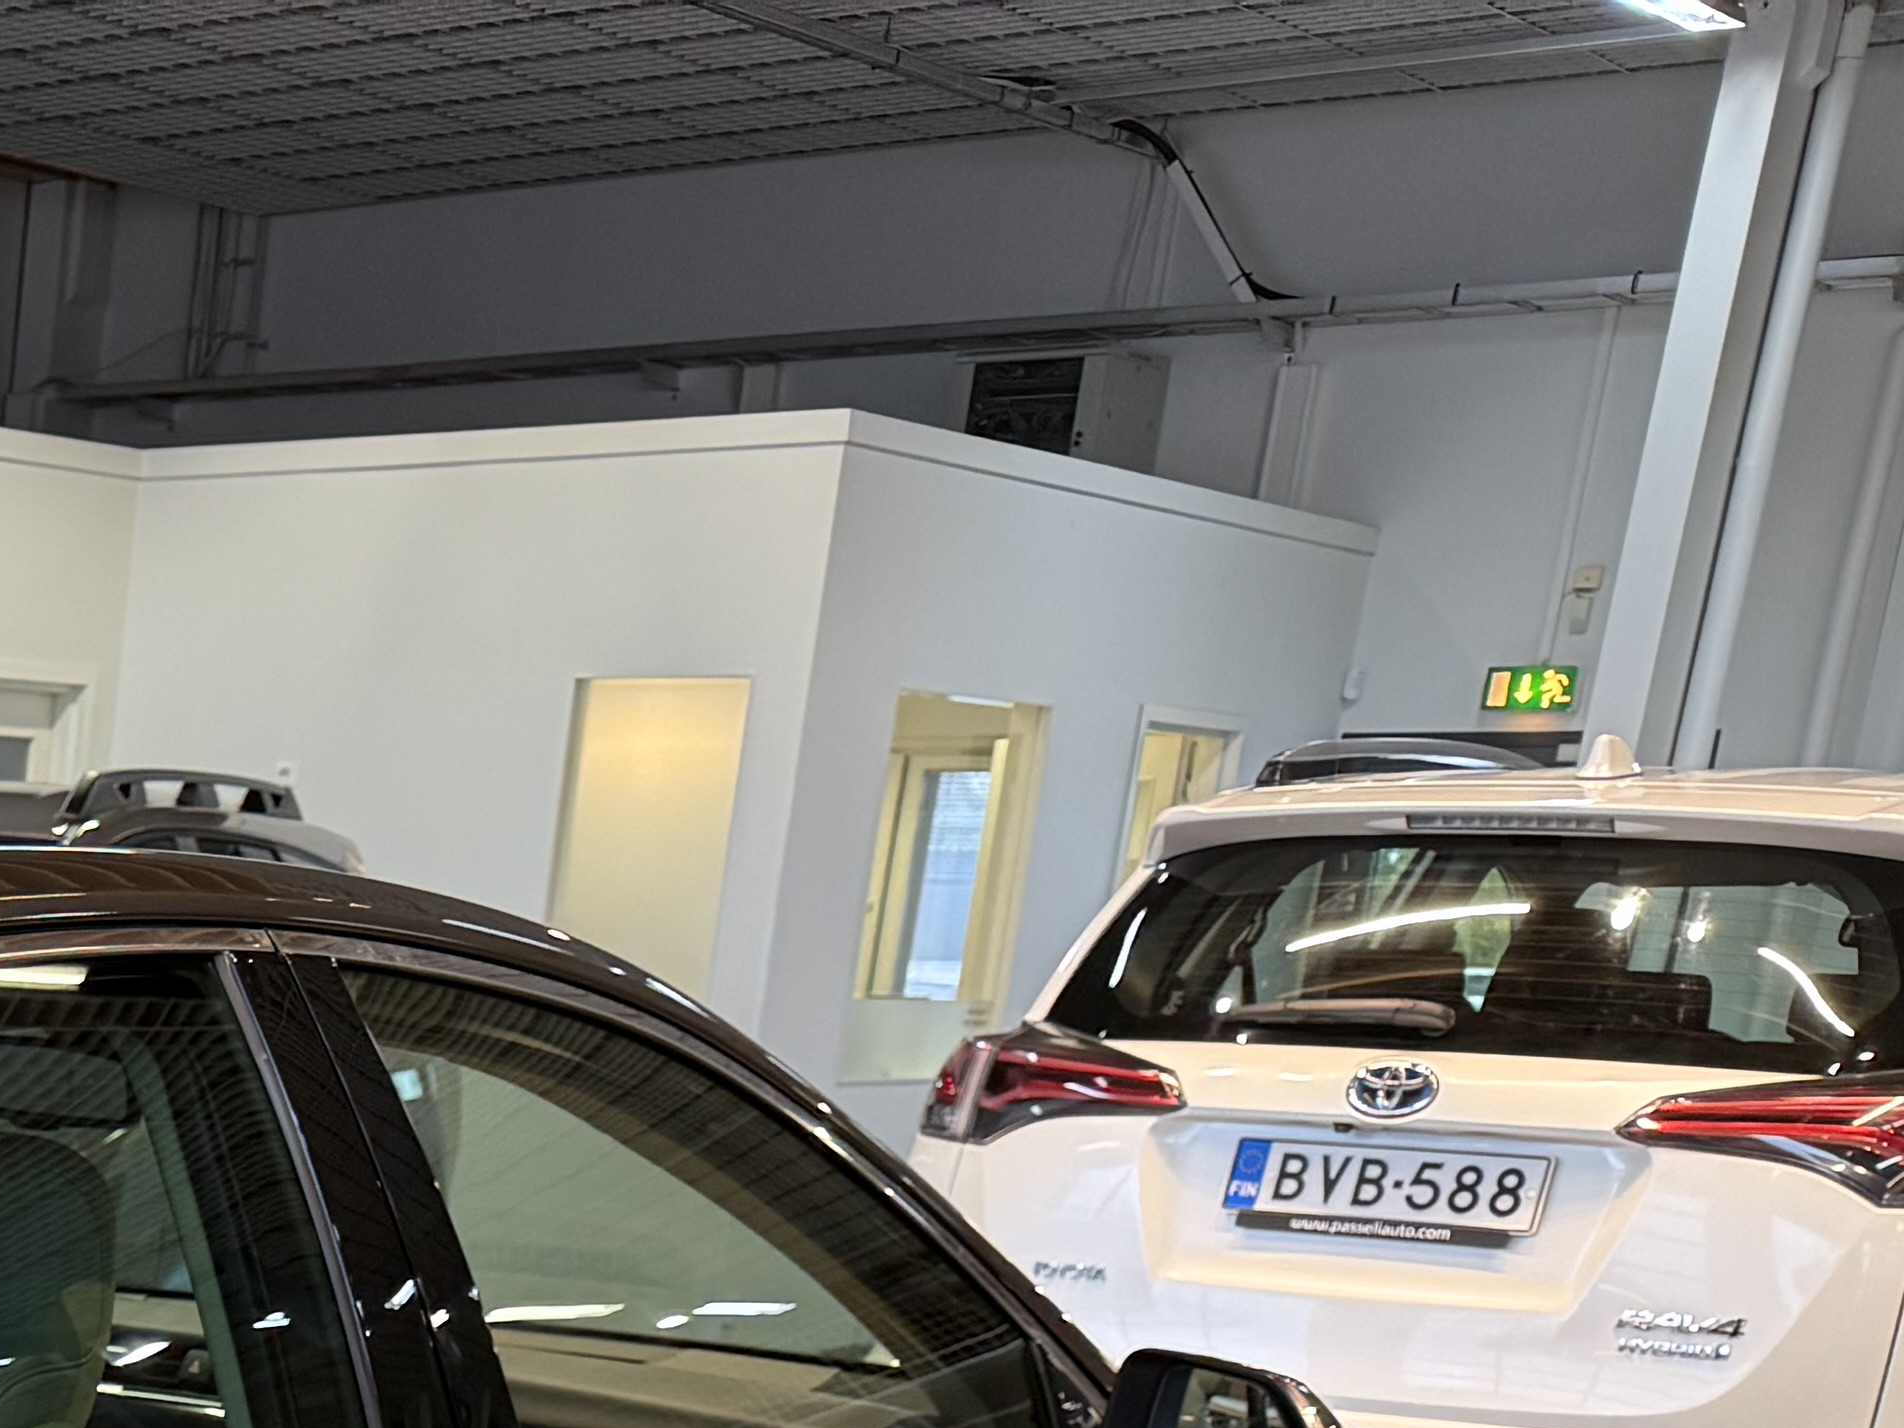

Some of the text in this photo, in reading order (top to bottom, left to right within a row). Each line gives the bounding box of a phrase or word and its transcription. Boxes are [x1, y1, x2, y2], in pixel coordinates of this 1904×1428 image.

[1228, 1179, 1259, 1198] FIN
[1271, 1151, 1527, 1219] BVB-588
[1289, 1218, 1451, 1242] www.passeliauto.com
